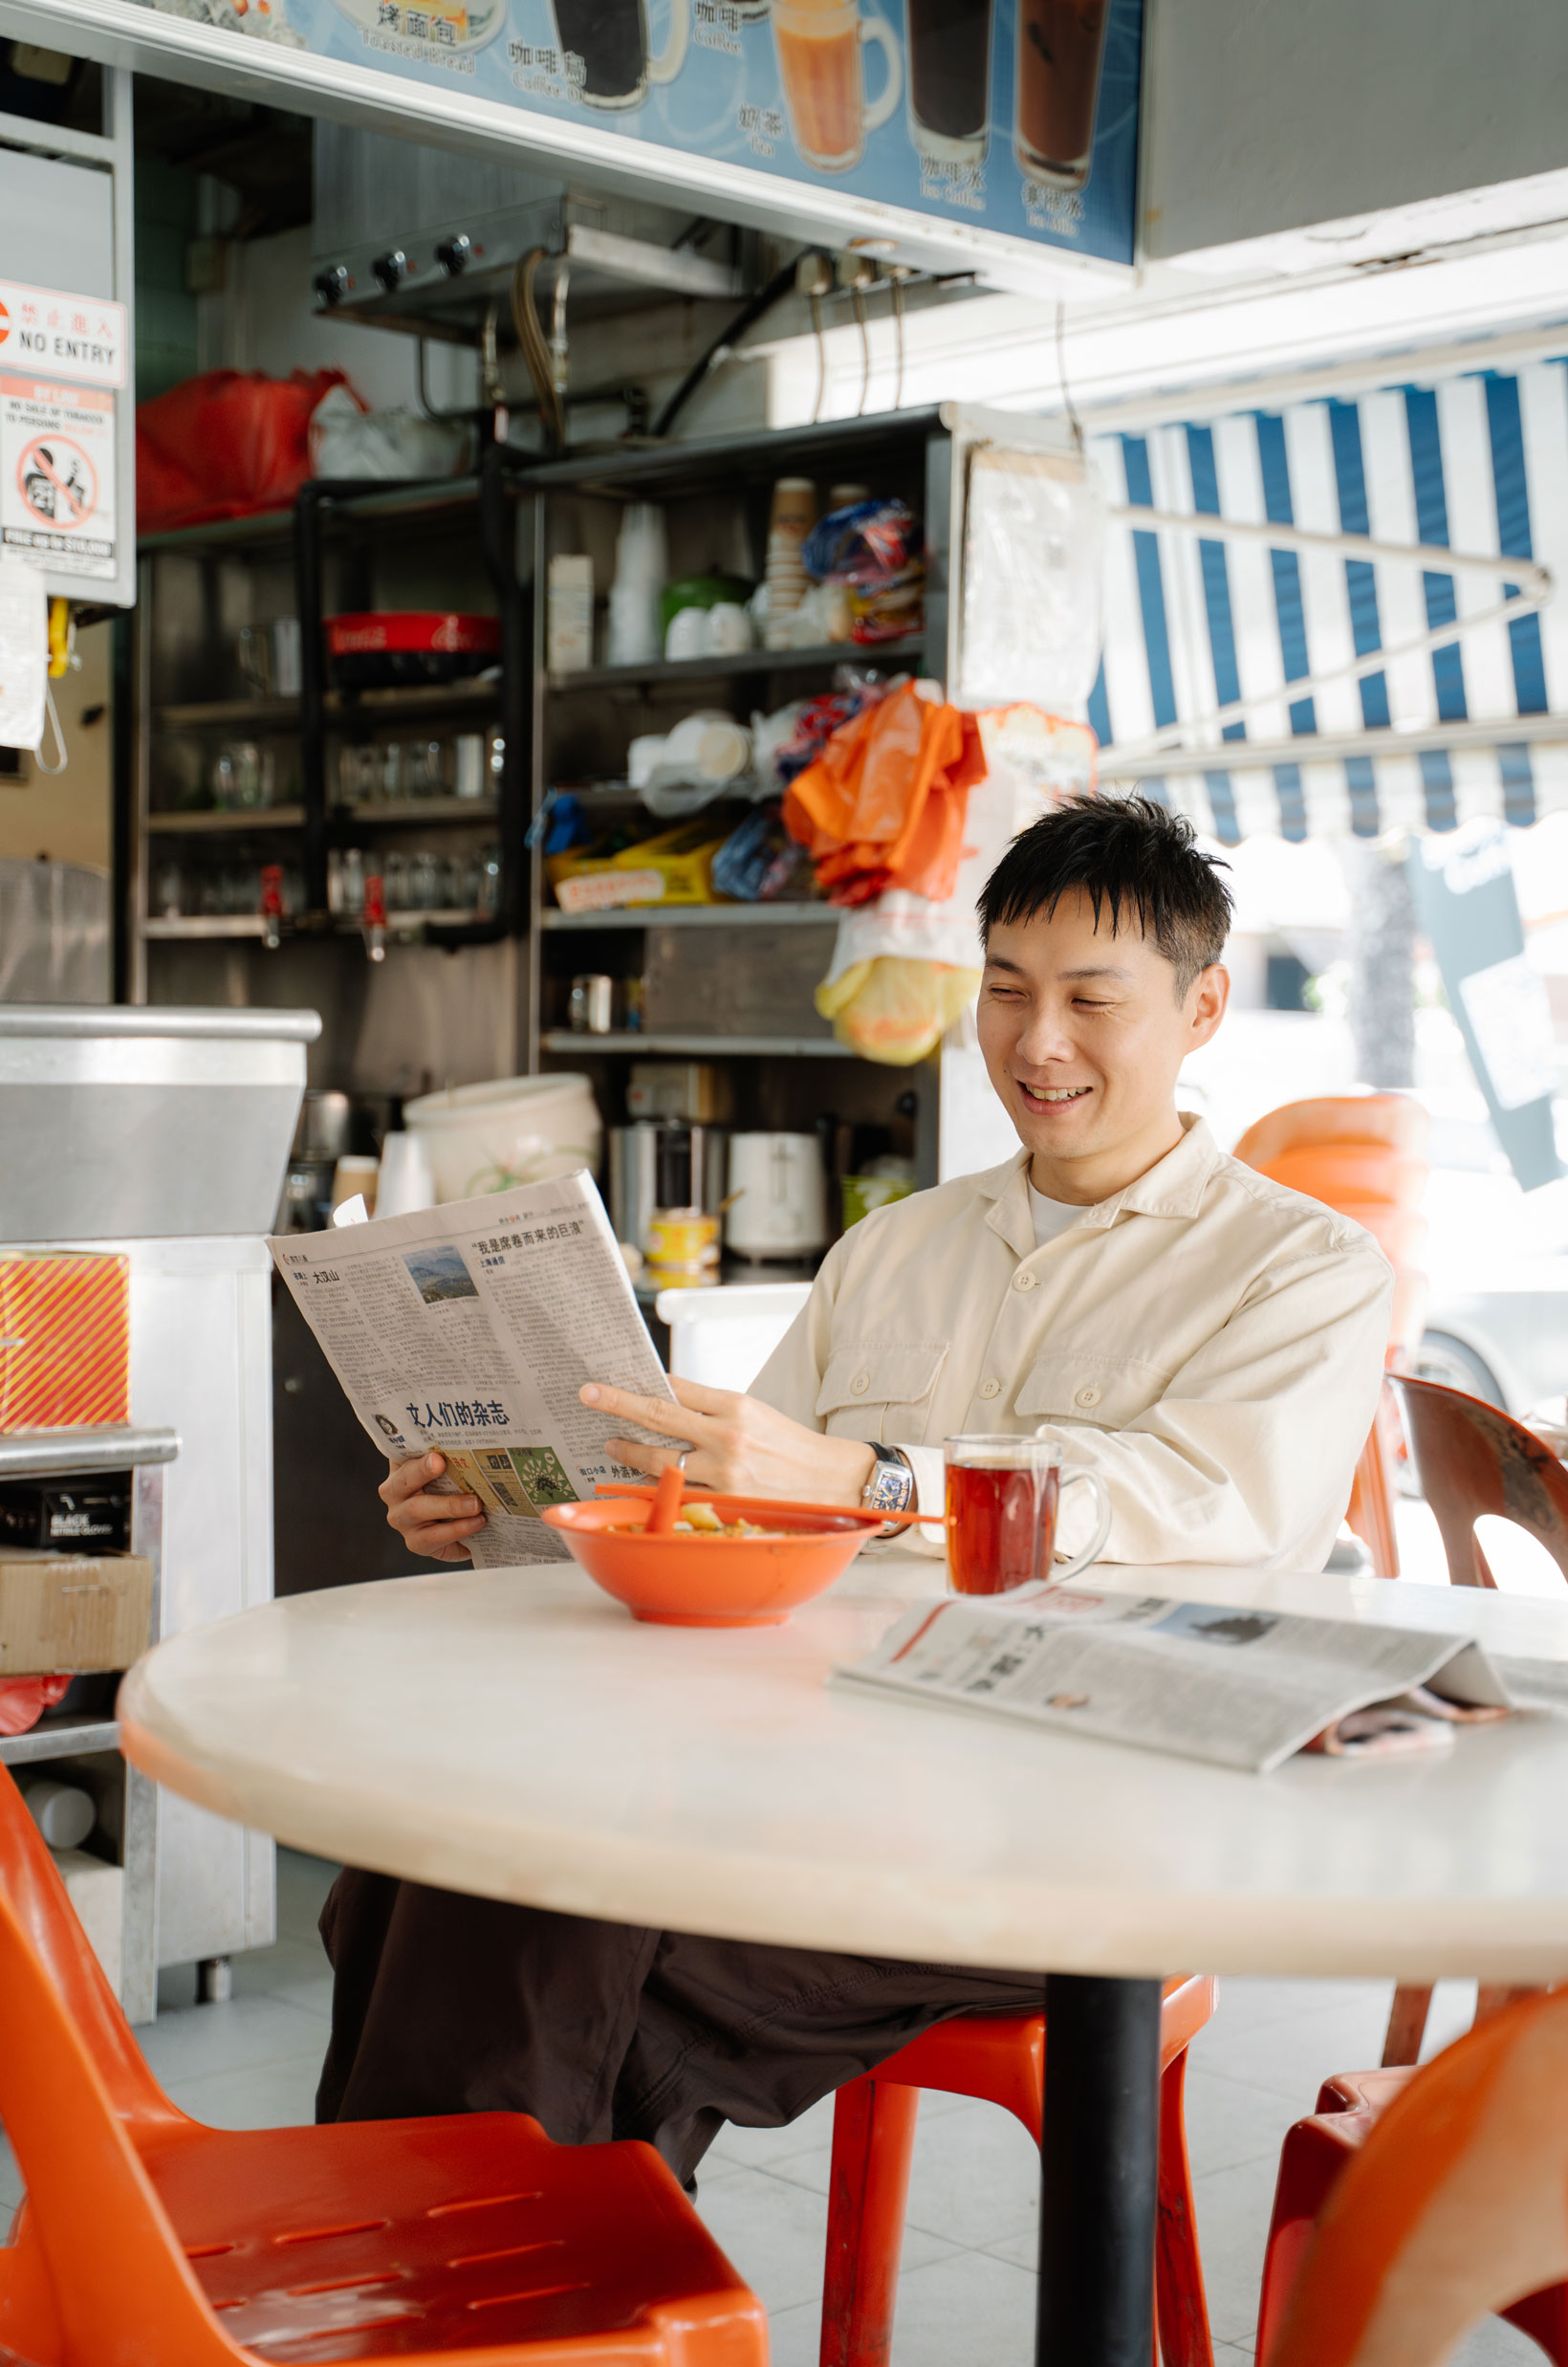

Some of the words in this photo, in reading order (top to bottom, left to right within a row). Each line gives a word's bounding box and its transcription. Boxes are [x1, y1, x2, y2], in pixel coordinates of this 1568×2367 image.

[377, 5, 456, 47] 烤面包
[428, 49, 475, 75] Bread
[512, 71, 562, 98] Coffee
[22, 302, 114, 340] 禁止進入
[20, 331, 46, 353] NO
[54, 338, 115, 366] ENTRY
[471, 1219, 584, 1256] “我是席卷而来的巨浪”
[313, 1269, 339, 1284] 大汉山
[405, 1400, 510, 1428] 文人们的杂志
[51, 1514, 90, 1526] BLACK
